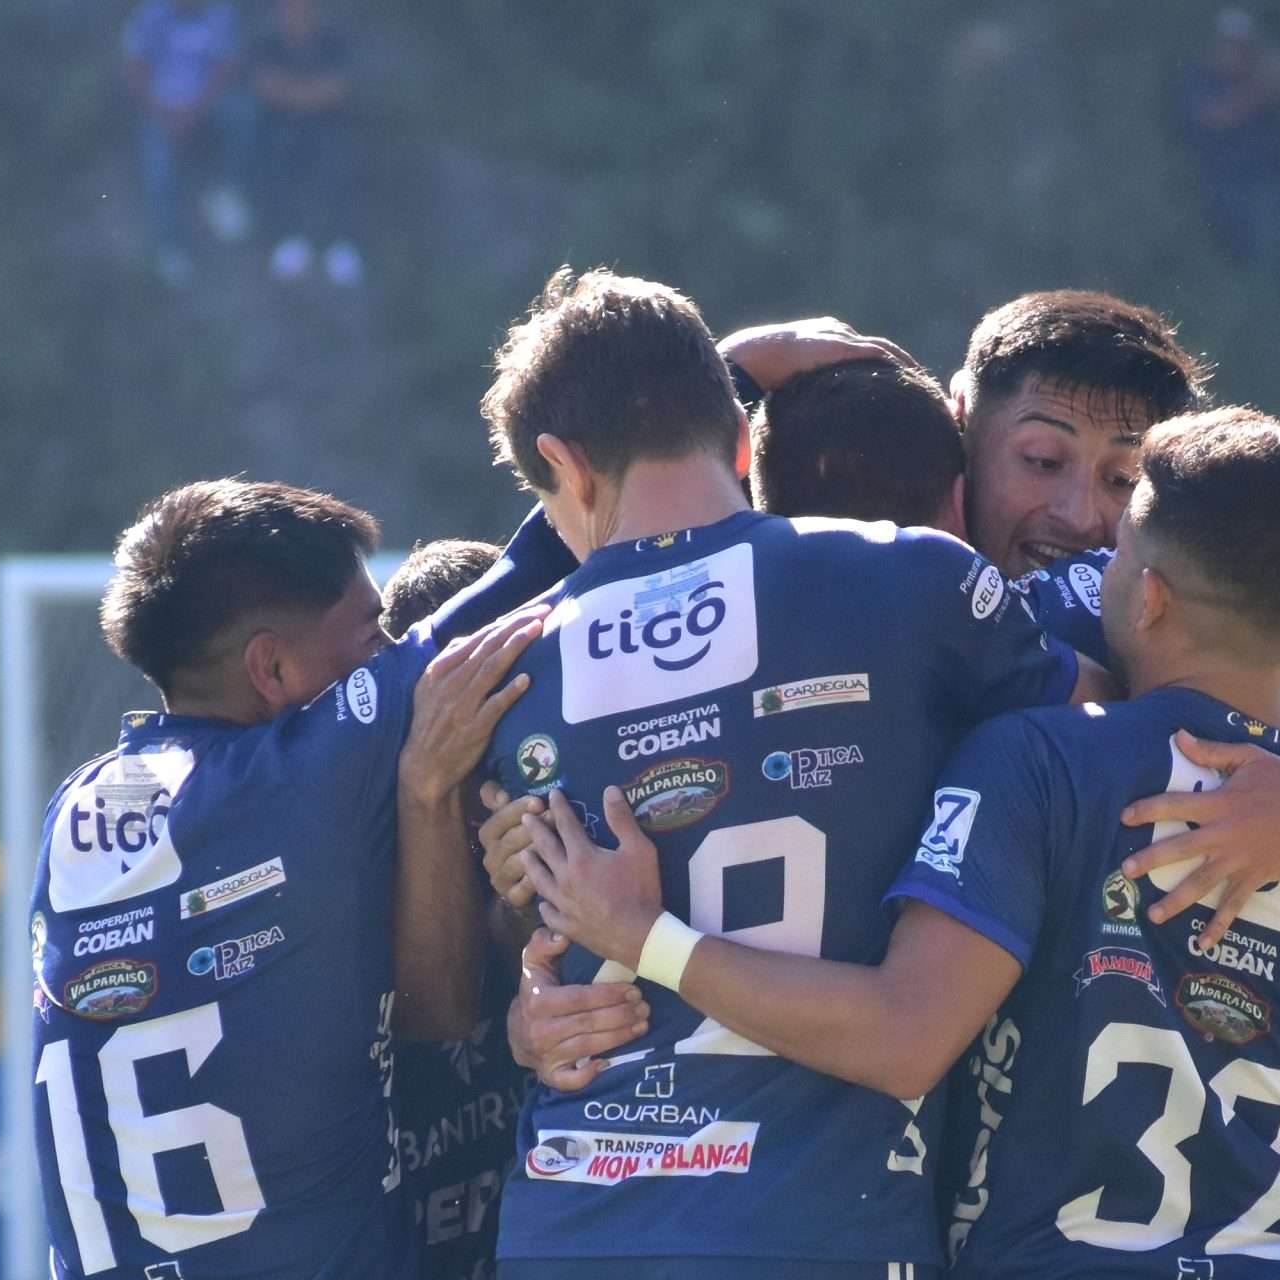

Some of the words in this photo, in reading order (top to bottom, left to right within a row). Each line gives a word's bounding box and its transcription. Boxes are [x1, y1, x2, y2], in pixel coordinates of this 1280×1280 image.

[975, 570, 1000, 614] CELCO
[352, 670, 374, 718] CELCO
[783, 679, 869, 698] CARDEGUA
[617, 703, 721, 737] COOPERATIVA
[617, 716, 721, 761] COBÁN
[625, 768, 718, 805] VALPARAISO
[205, 864, 283, 899] CARDEGUA
[78, 905, 155, 934] COOPERATIVA
[73, 919, 155, 957] COBÁN
[70, 970, 148, 1000] VALPARAISO
[584, 1101, 721, 1125] COURBAN
[35, 1001, 266, 1277] 16
[660, 1141, 750, 1170] BLANCA
